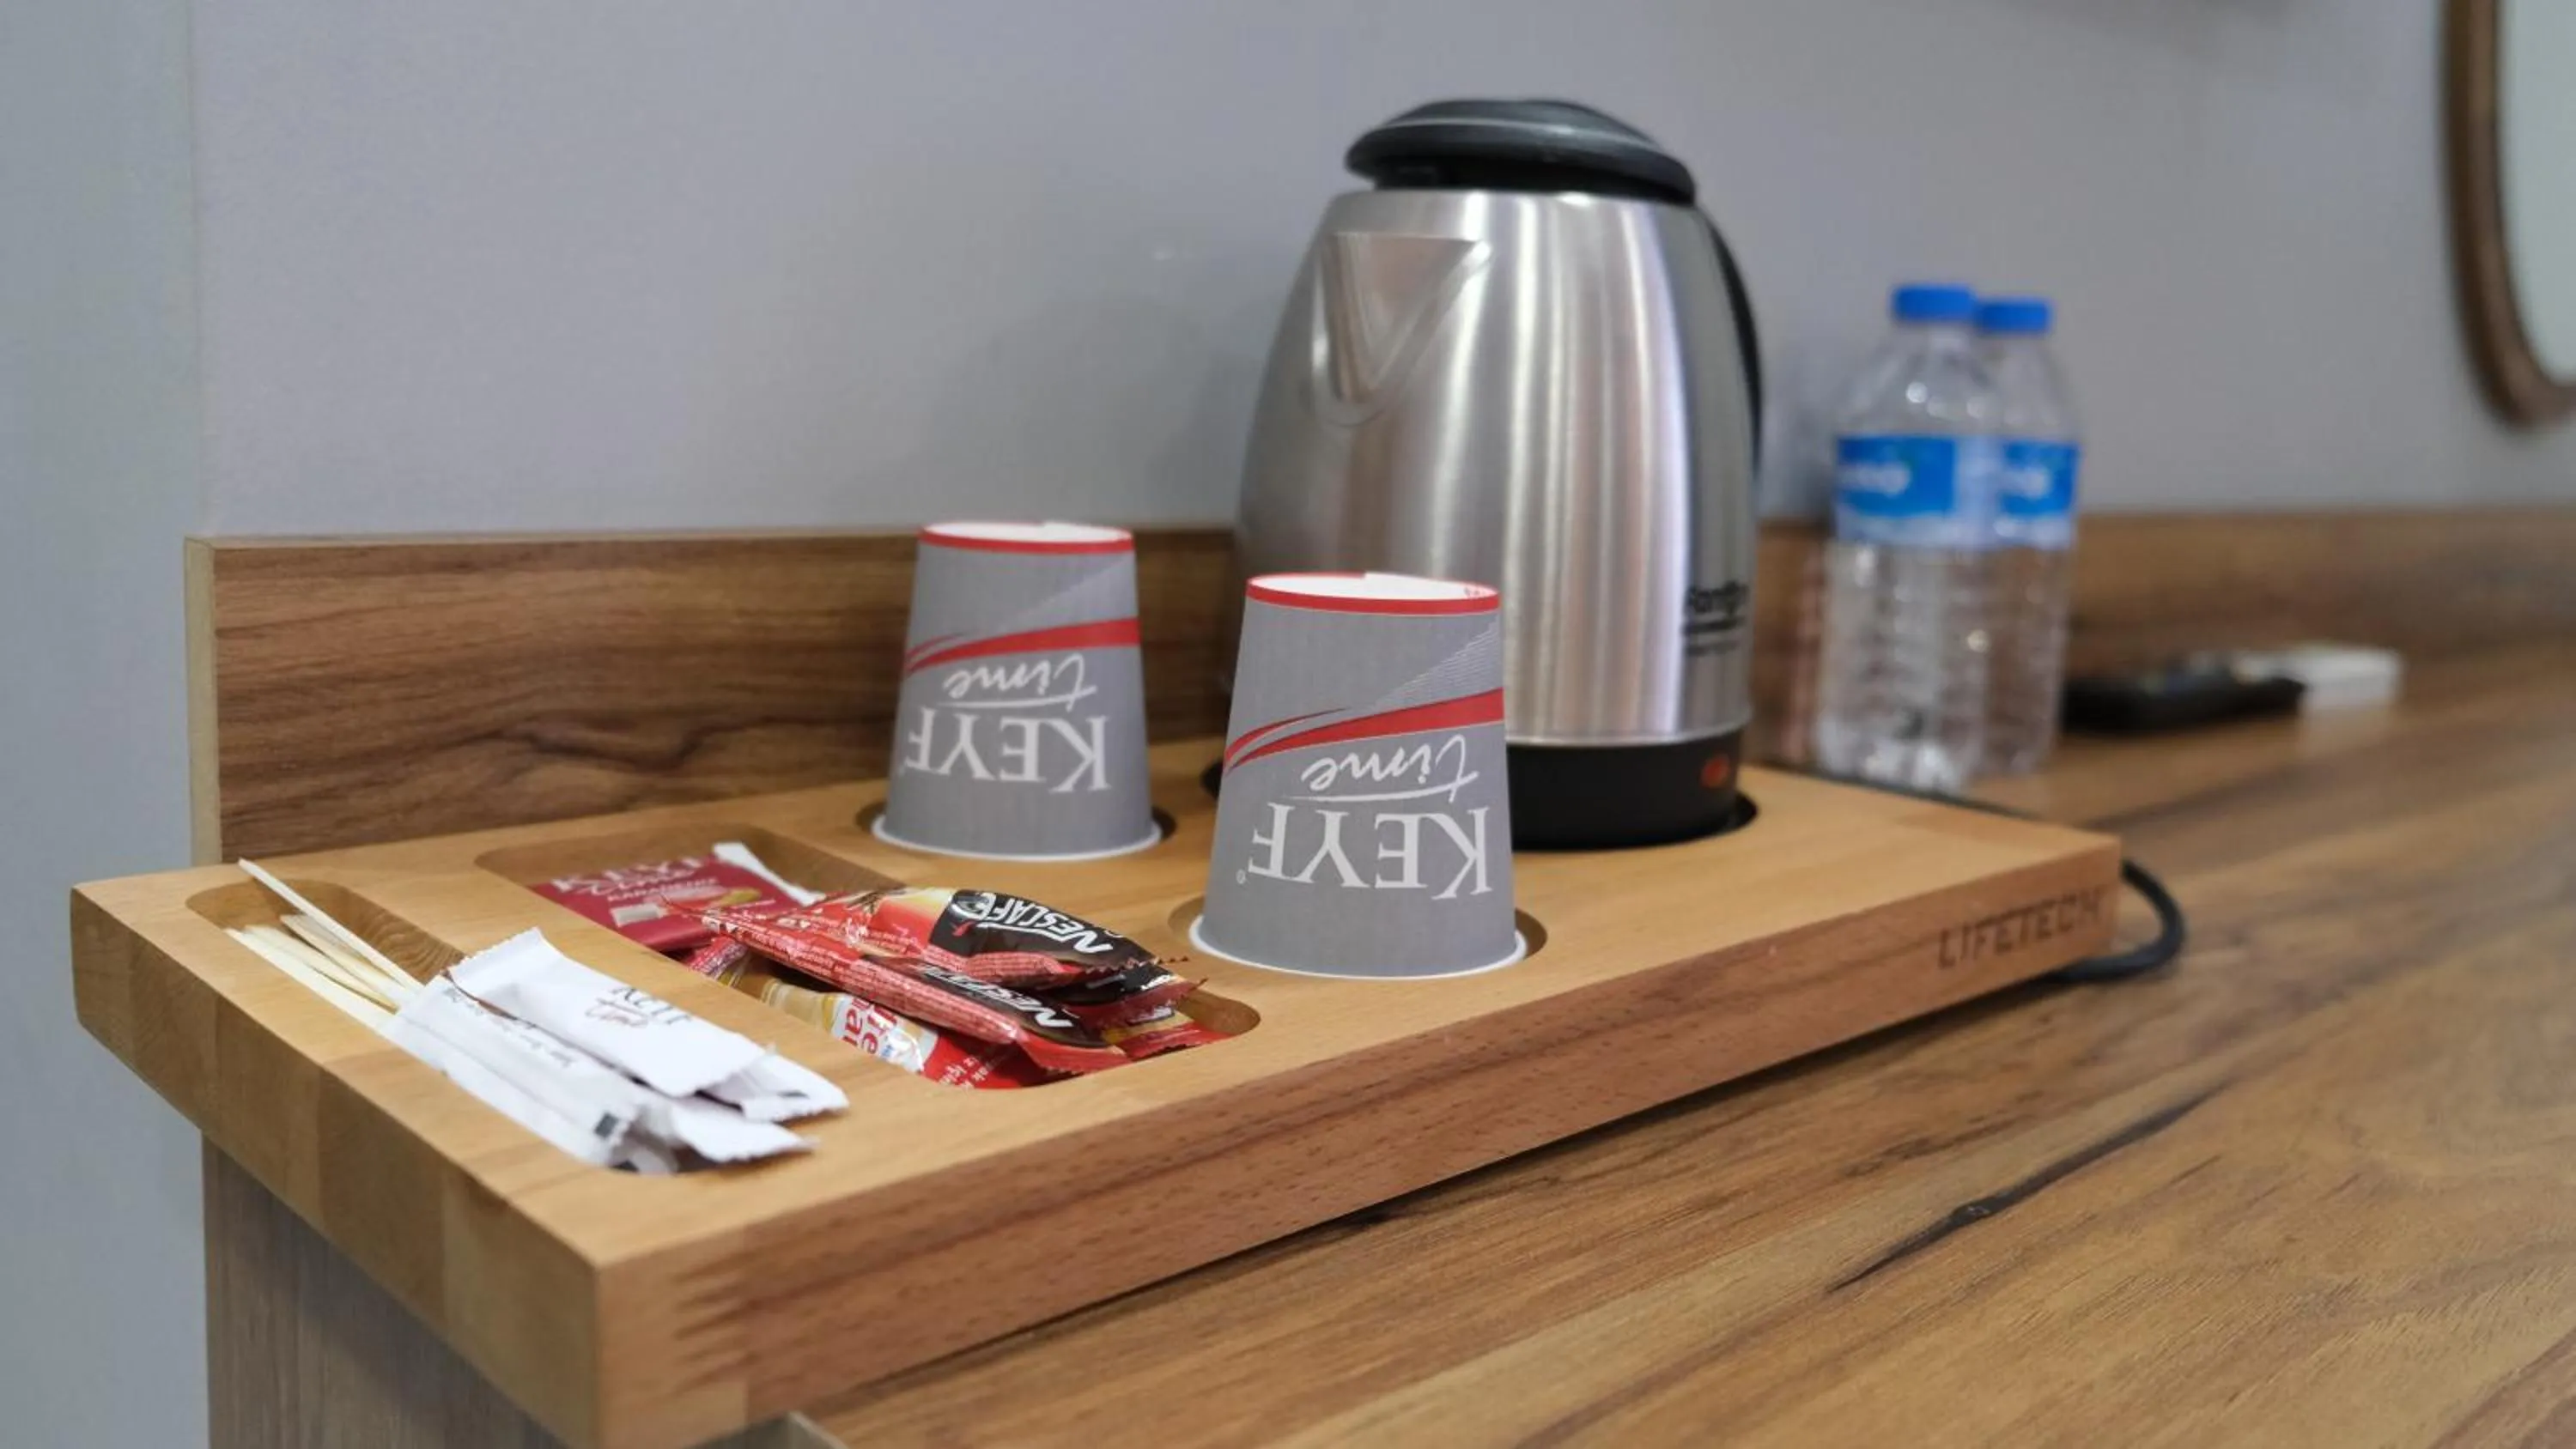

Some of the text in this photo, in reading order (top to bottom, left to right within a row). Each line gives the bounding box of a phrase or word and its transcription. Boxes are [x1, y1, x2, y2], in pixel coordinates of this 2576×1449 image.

[938, 653, 1097, 712] time
[904, 706, 1112, 794] KEYF
[1284, 734, 1479, 803] time
[1248, 802, 1492, 900] KEYF
